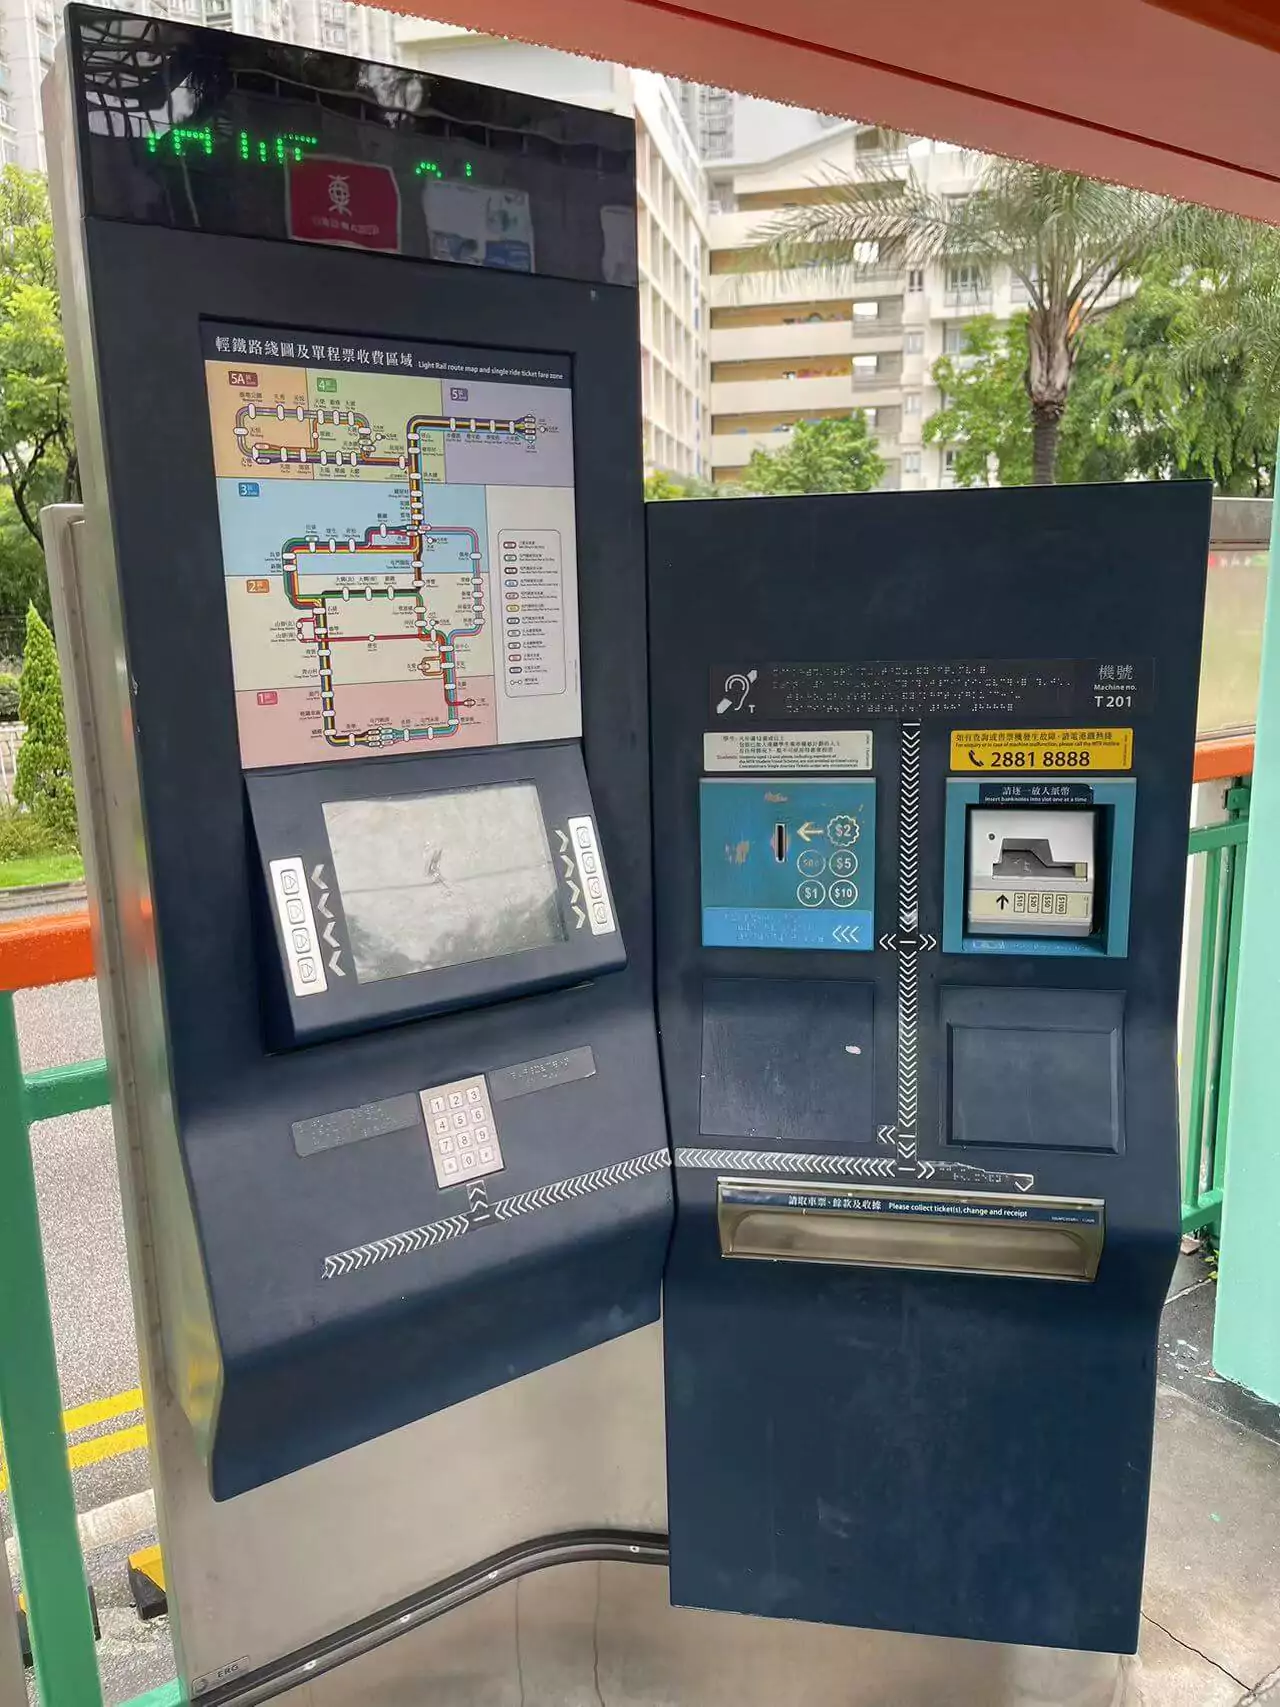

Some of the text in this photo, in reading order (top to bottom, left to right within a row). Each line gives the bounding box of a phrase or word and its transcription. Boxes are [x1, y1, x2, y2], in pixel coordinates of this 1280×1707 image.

[418, 361, 435, 369] Light
[436, 362, 447, 370] Rail
[448, 363, 464, 371] route
[465, 366, 478, 374] map
[491, 367, 509, 375] single
[231, 373, 245, 385] 5A
[452, 388, 459, 400] 5
[240, 484, 248, 496] 3
[1099, 664, 1133, 680] 機號
[748, 704, 756, 714] T
[990, 751, 1090, 768] 2881 8888
[834, 823, 852, 838] $2
[836, 857, 852, 870] $5
[804, 886, 853, 899] $1 $10
[888, 1202, 1028, 1218] Please collect ticket(s), change and receipt
